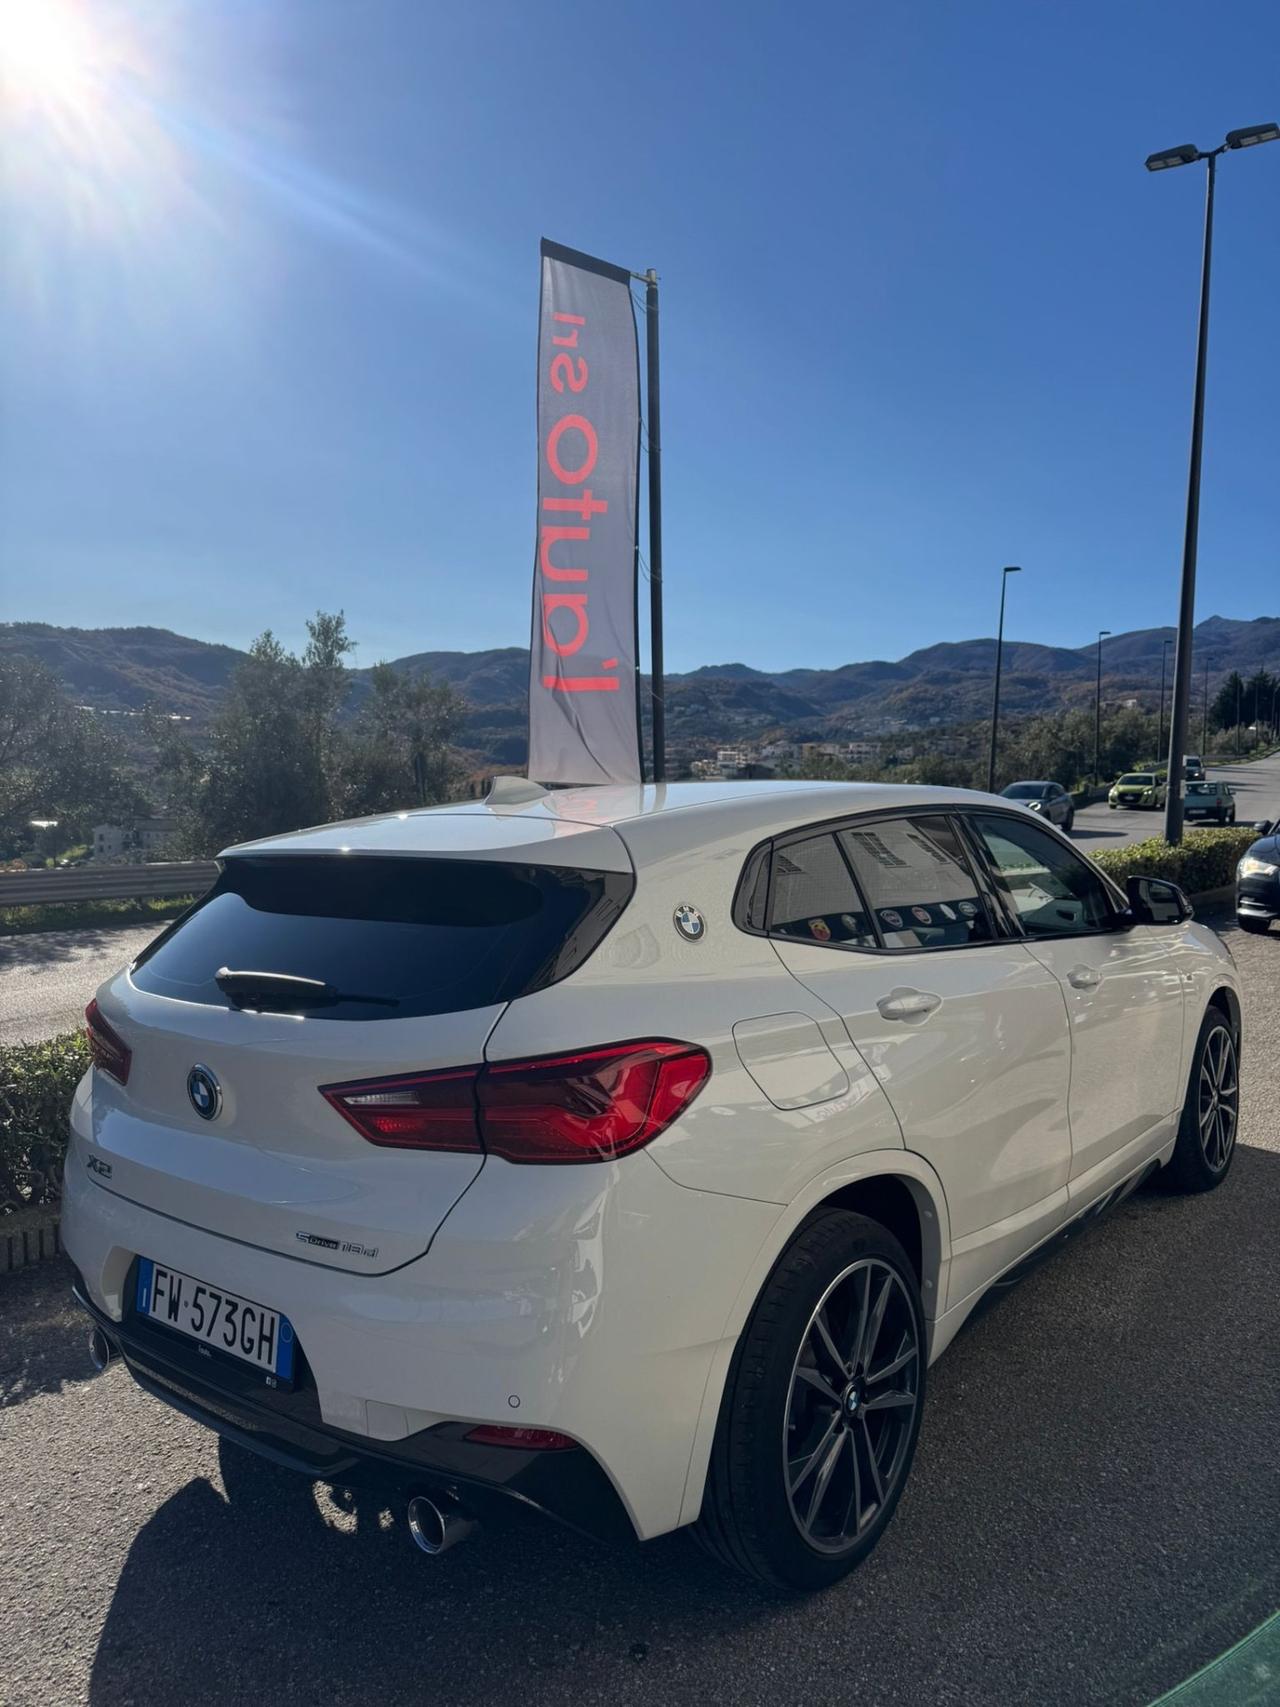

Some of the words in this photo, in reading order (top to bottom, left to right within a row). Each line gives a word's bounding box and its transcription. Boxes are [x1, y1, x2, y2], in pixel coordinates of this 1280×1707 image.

[87, 1153, 112, 1179] X2
[152, 1268, 182, 1323] FW
[190, 1285, 276, 1366] 573GH
